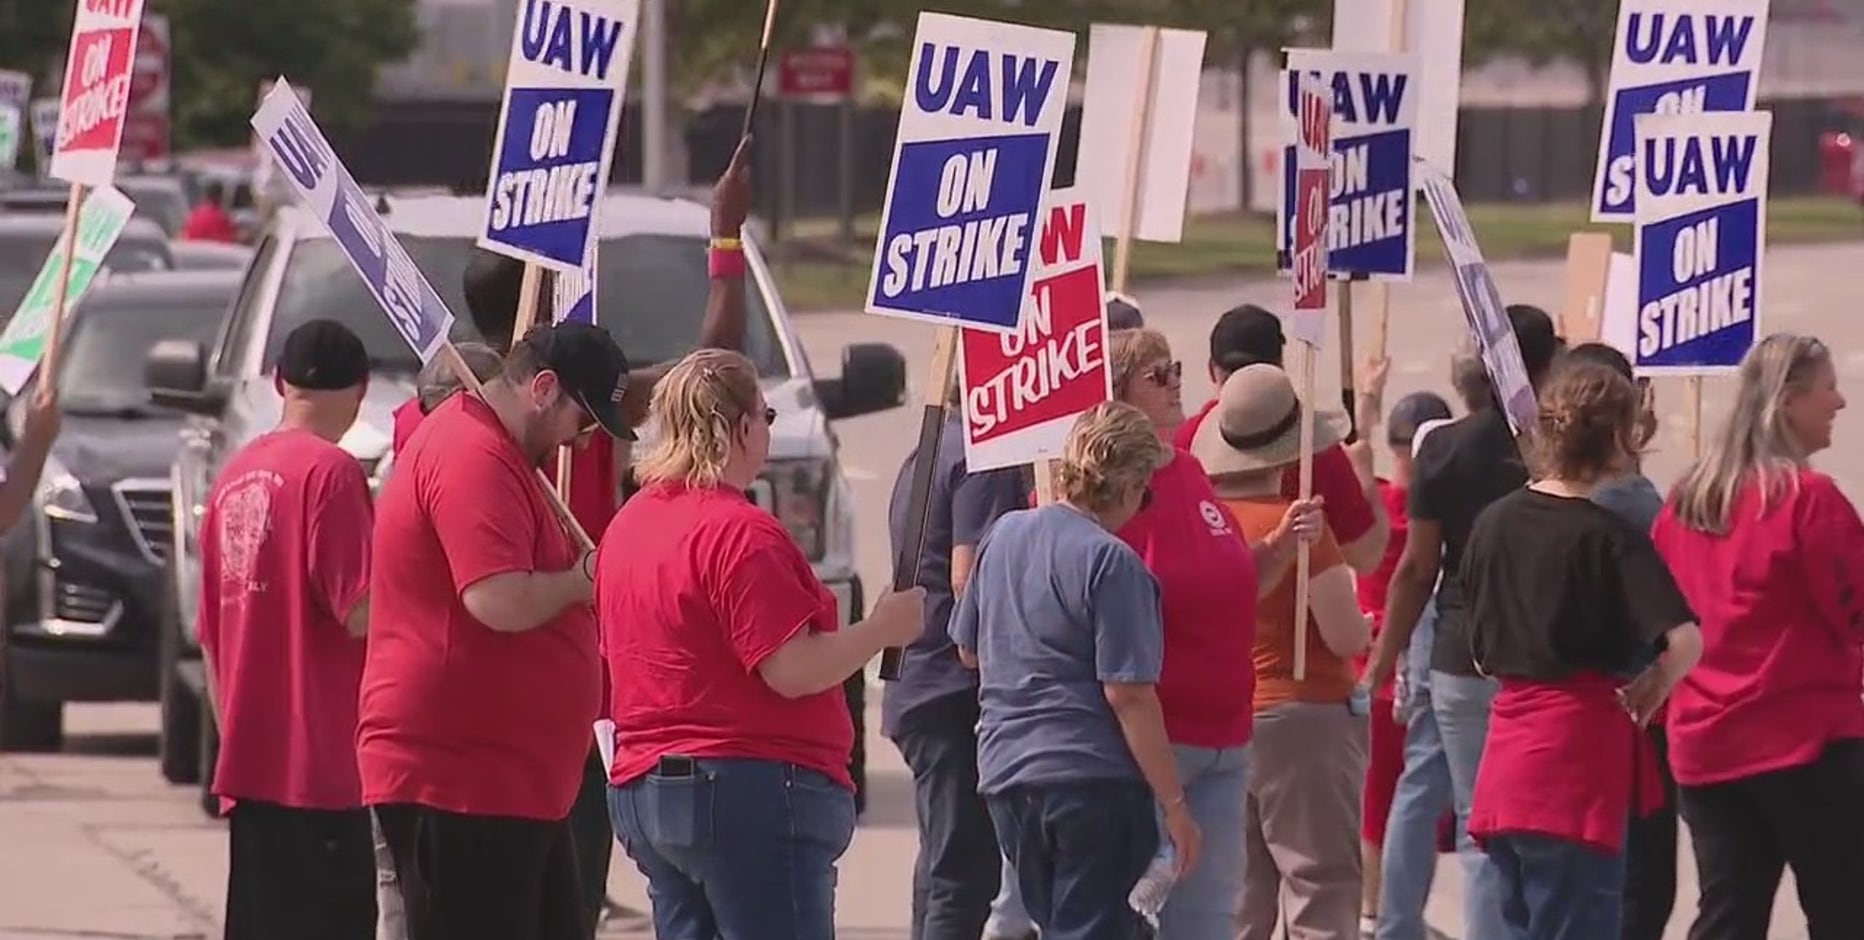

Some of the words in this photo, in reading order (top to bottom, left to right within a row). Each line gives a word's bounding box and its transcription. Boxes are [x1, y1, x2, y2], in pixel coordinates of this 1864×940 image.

[521, 0, 622, 80] UAW
[1626, 12, 1754, 66] UAW
[914, 42, 1058, 126] UAW
[530, 101, 576, 161] ON
[1645, 135, 1757, 196] UAW
[492, 161, 597, 232] STRIKE
[936, 148, 998, 219] ON
[882, 212, 1029, 298] STRIKE
[1673, 216, 1718, 283] ON
[1638, 266, 1751, 358] STRIKE
[969, 319, 1104, 438] STRIKE
